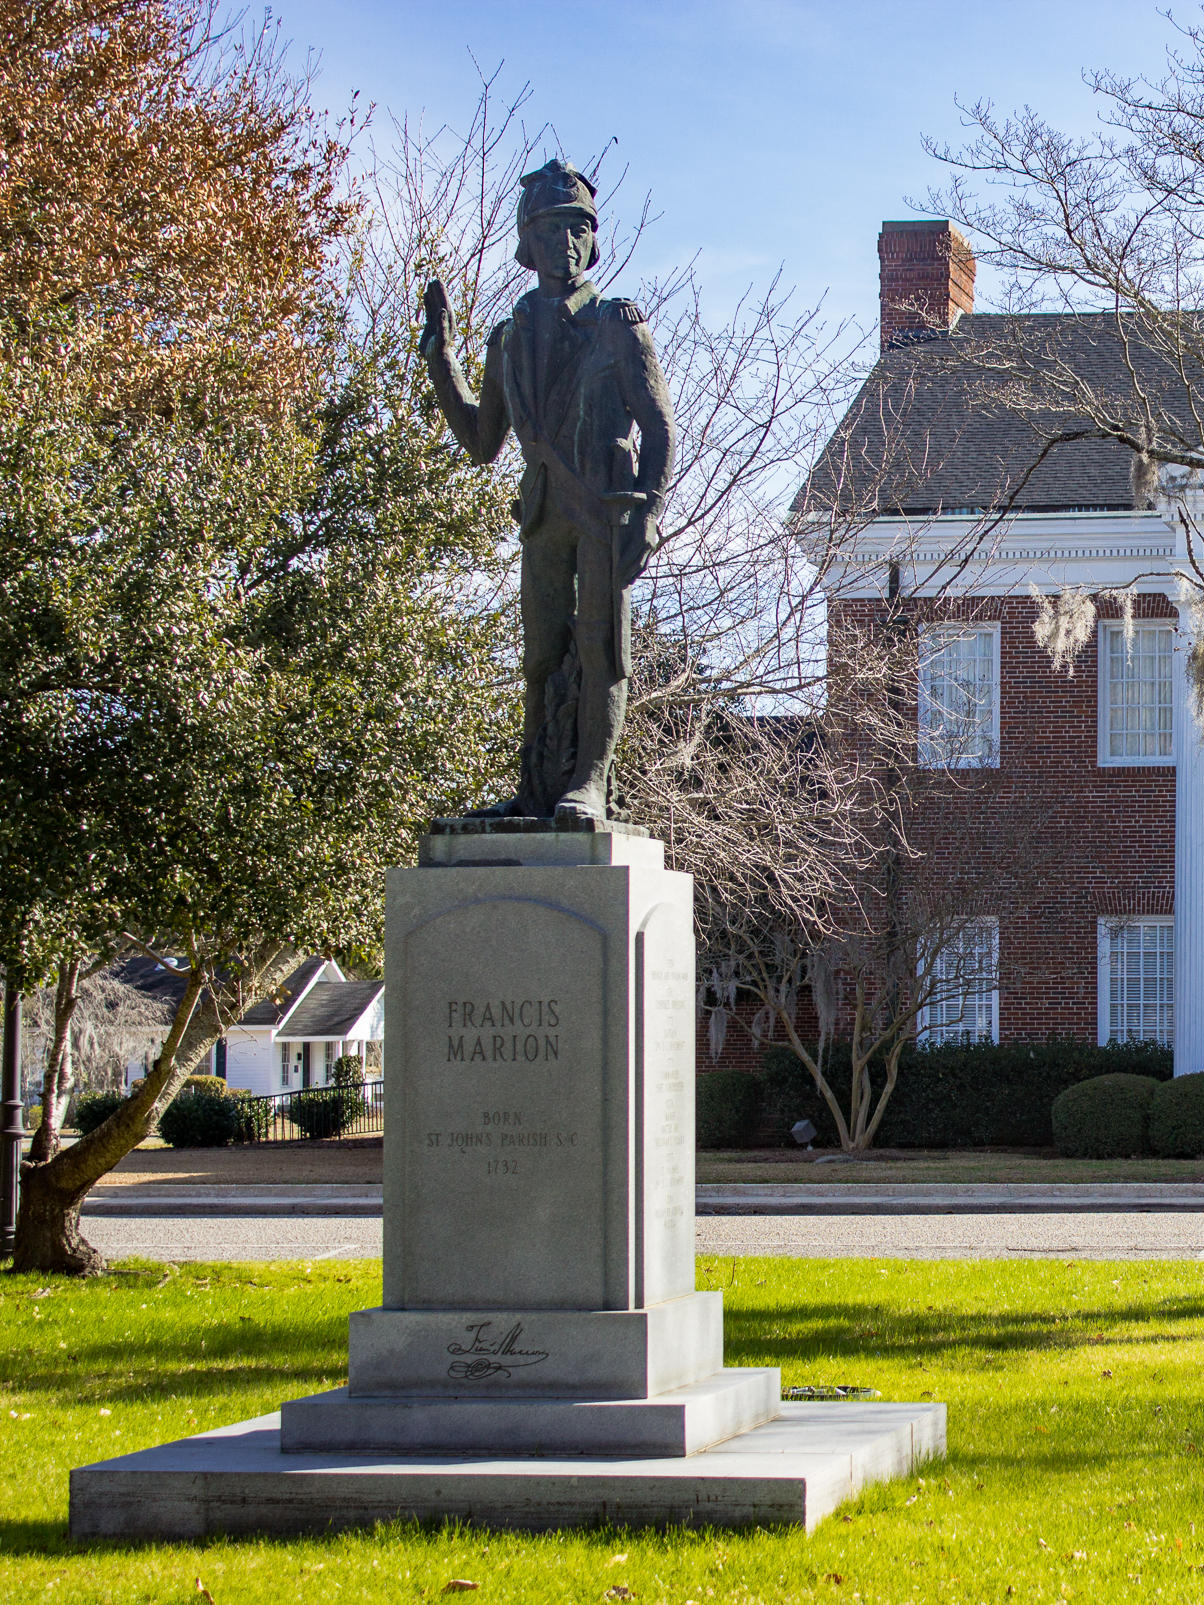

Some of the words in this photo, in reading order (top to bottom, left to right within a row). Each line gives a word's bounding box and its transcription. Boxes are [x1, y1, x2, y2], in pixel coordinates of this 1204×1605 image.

[447, 1000, 560, 1028] FRANCIS
[446, 1034, 560, 1062] MARION
[483, 1111, 522, 1126] BORN
[427, 1132, 444, 1147] ST.
[448, 1131, 493, 1147] JOHN'S
[501, 1132, 548, 1147] PARISH
[486, 1159, 518, 1175] 1732
